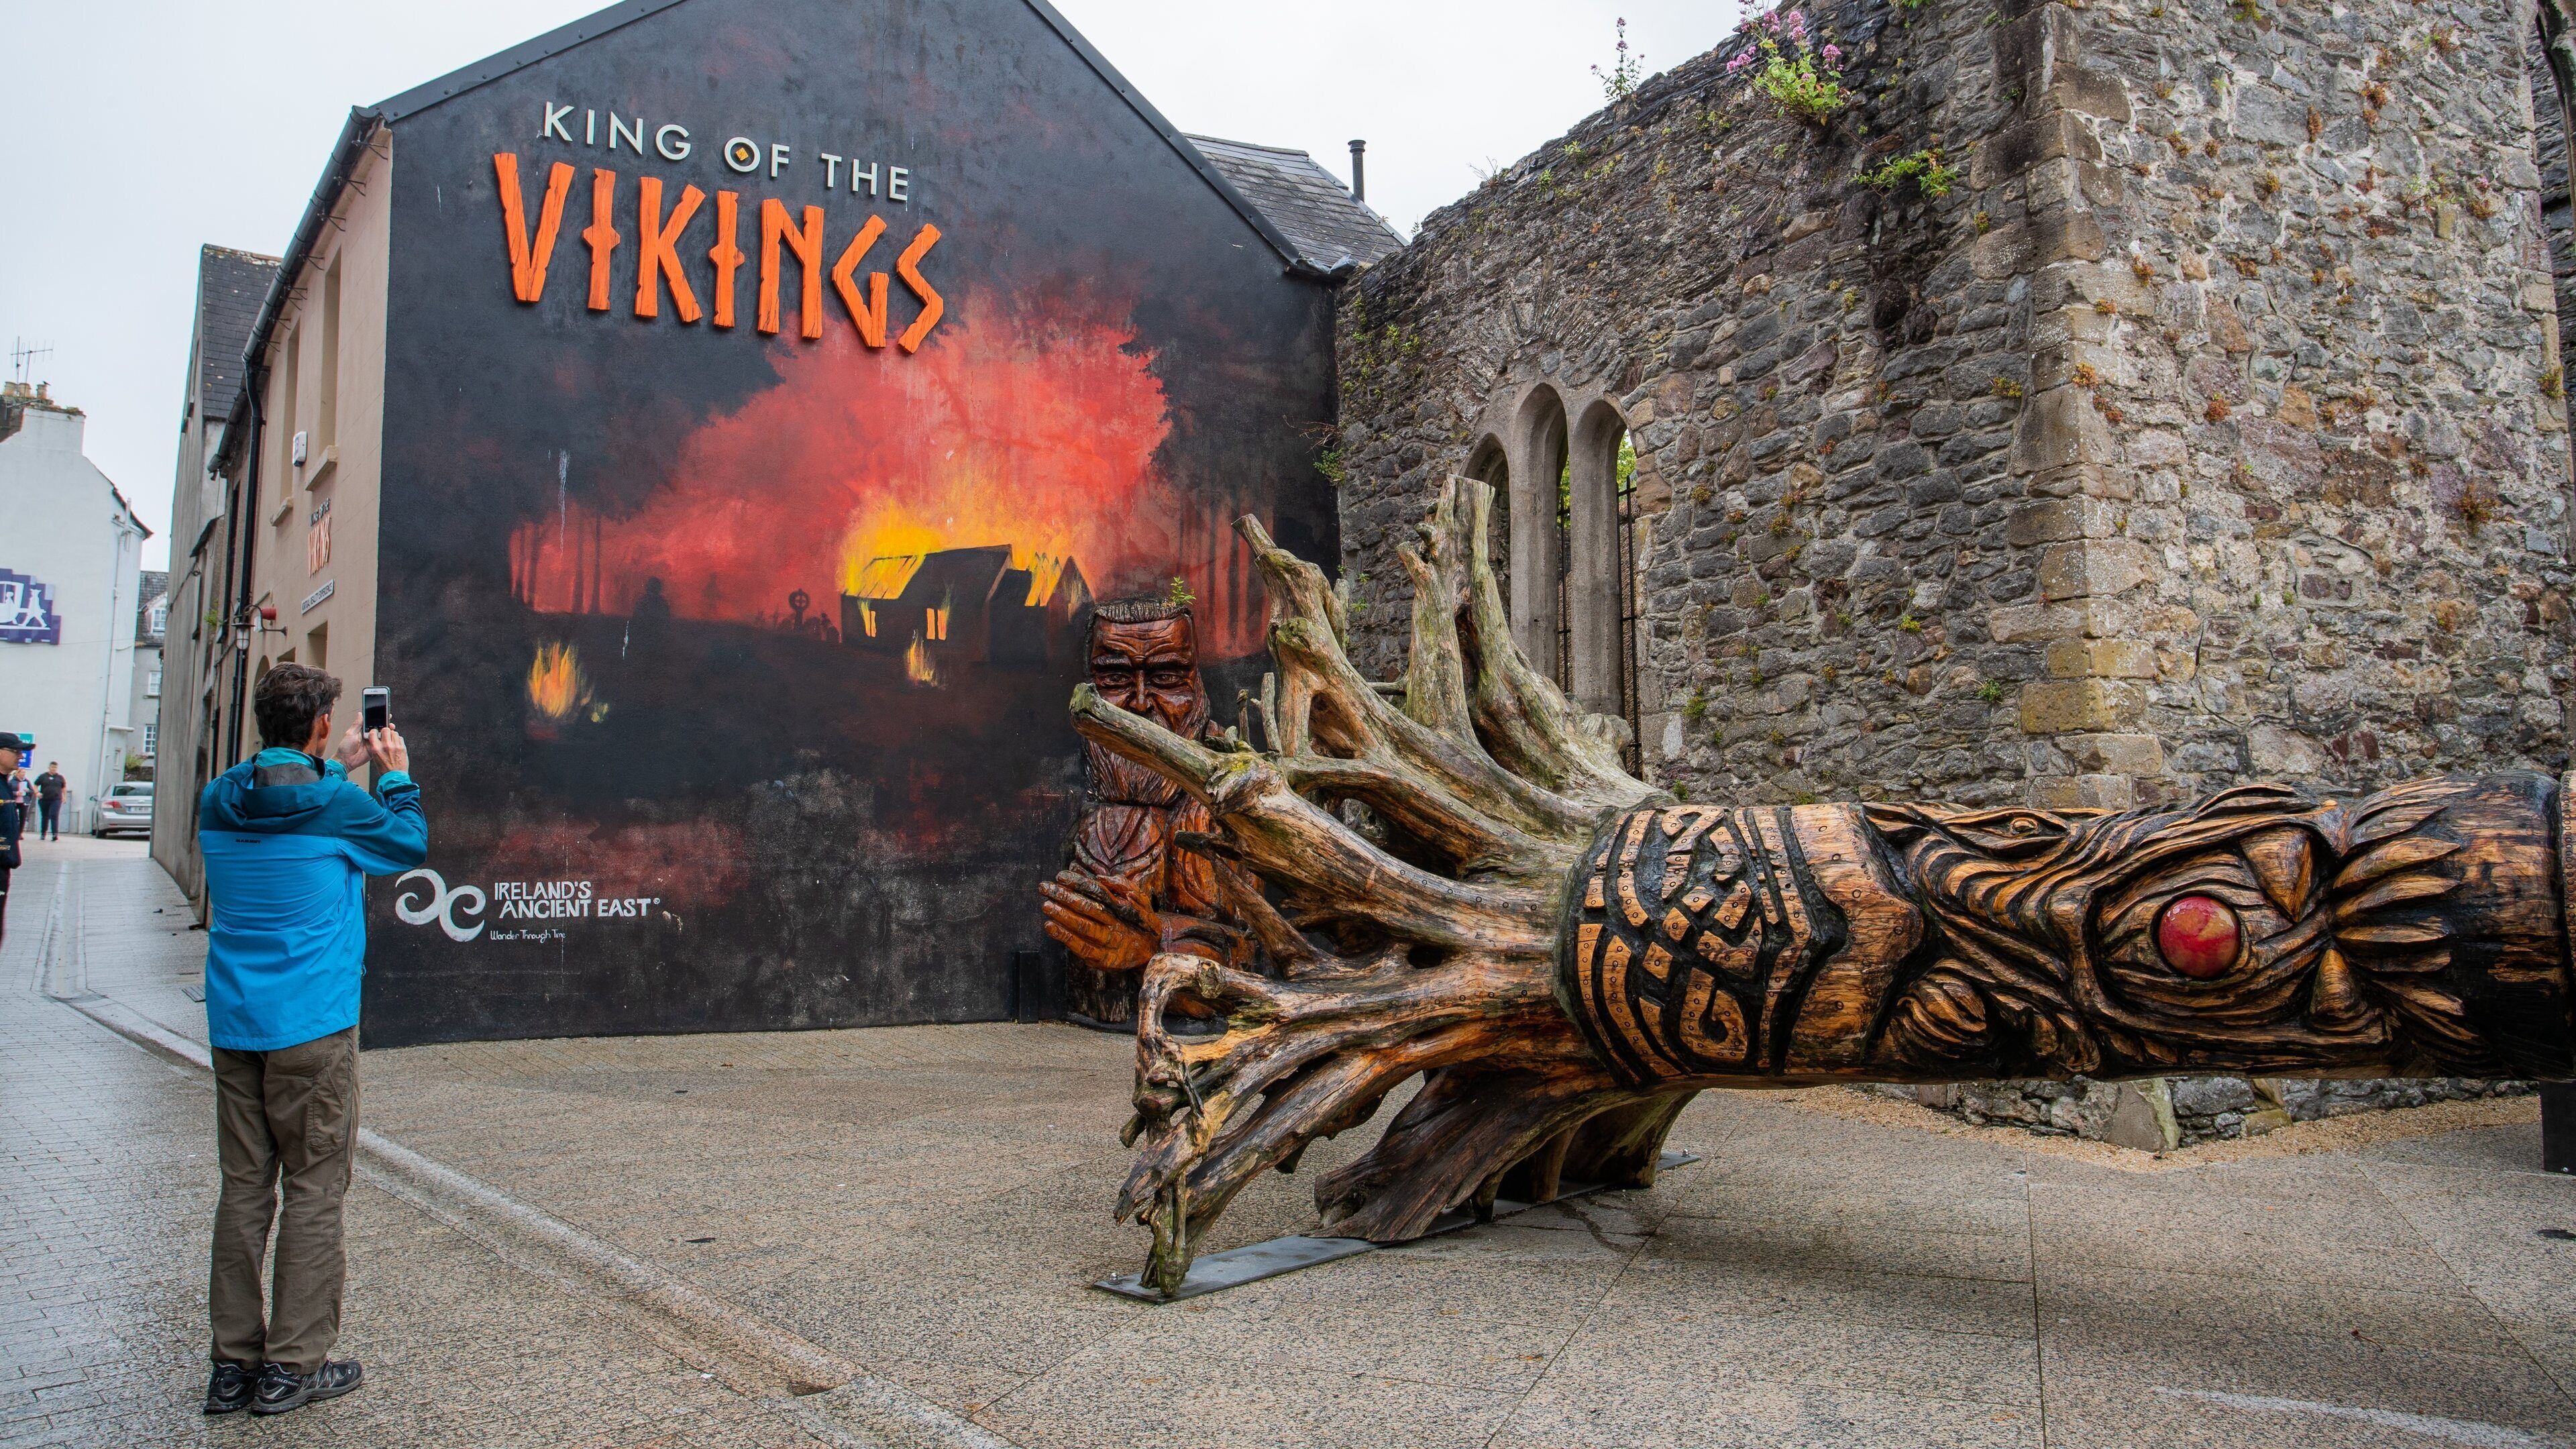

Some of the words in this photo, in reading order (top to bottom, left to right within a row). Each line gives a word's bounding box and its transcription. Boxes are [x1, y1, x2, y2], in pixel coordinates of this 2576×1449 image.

[543, 101, 692, 161] KING
[724, 136, 790, 178] OF
[820, 152, 908, 201] THE
[494, 152, 945, 355] VIKINGS
[494, 881, 592, 900] IRELAND'S
[498, 899, 592, 919] ANCIENT
[490, 930, 520, 941] Wander
[520, 929, 551, 944] Through
[551, 928, 566, 938] Time
